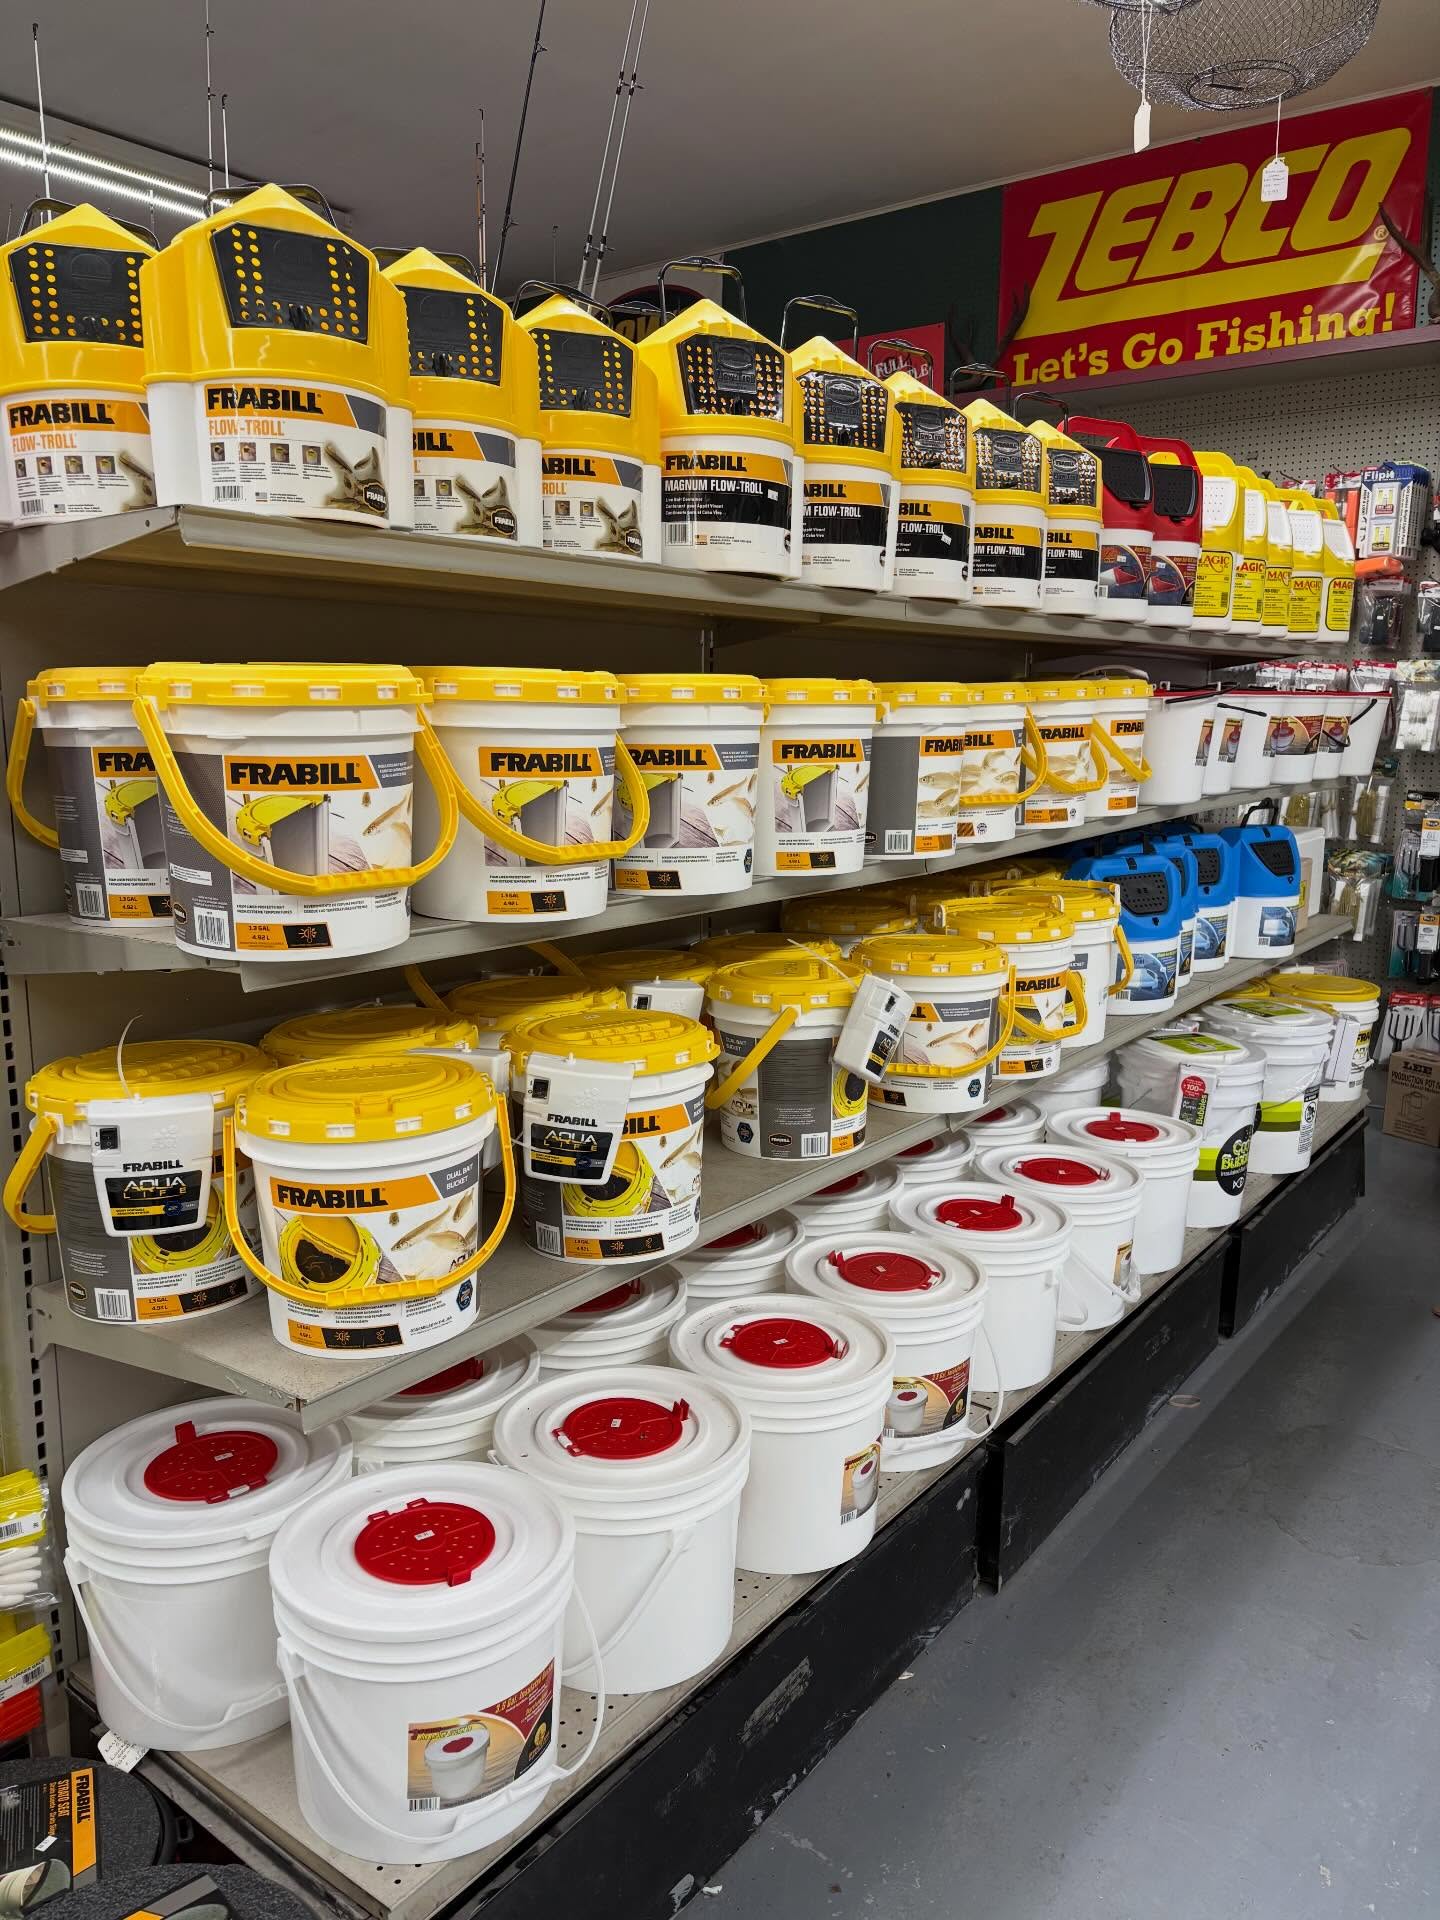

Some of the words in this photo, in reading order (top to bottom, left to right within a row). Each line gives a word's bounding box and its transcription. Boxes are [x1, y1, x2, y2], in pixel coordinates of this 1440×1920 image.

[1013, 127, 1411, 340] ZEBCO
[1012, 341, 1108, 387] Let's
[1122, 331, 1183, 369] Go
[1195, 291, 1396, 360] Fishing!
[206, 388, 324, 414] FRABILL
[9, 403, 114, 429] FRABILL
[208, 419, 285, 437] FLOW-TROLL
[12, 433, 77, 451] FLOW-TROLL
[413, 431, 454, 451] ILL
[665, 454, 748, 472] FRABILL
[665, 479, 708, 492] MAGNUM
[710, 480, 763, 495] FLOW-TROLL
[813, 505, 861, 518] FLOW-TROLL
[901, 523, 945, 535] FLOW-TROLL
[986, 545, 1025, 556] FLOW-TROLL
[1236, 562, 1264, 573] AGIC
[781, 743, 856, 760] FRABILL
[490, 752, 592, 772] FRABILL
[230, 763, 361, 785] FRABILL
[1402, 1061, 1433, 1075] LEE
[1391, 1070, 1424, 1087] PRODUCTION
[1424, 1079, 1436, 1089] POT
[1195, 1094, 1208, 1125] Bubbles
[546, 1113, 598, 1127] FRABILL
[543, 1130, 598, 1146] AQUA
[123, 1159, 184, 1173] FRABILL
[446, 1168, 463, 1181] DUAL
[462, 1162, 474, 1175] BAIT
[123, 1176, 187, 1193] AQUA
[446, 1175, 469, 1190] BUCKET
[123, 1186, 187, 1200] LIFE
[277, 1184, 388, 1209] FRABILL
[57, 1779, 70, 1802] STRATO
[76, 1774, 91, 1824] FRABILL
[57, 1802, 70, 1817] SEAT
